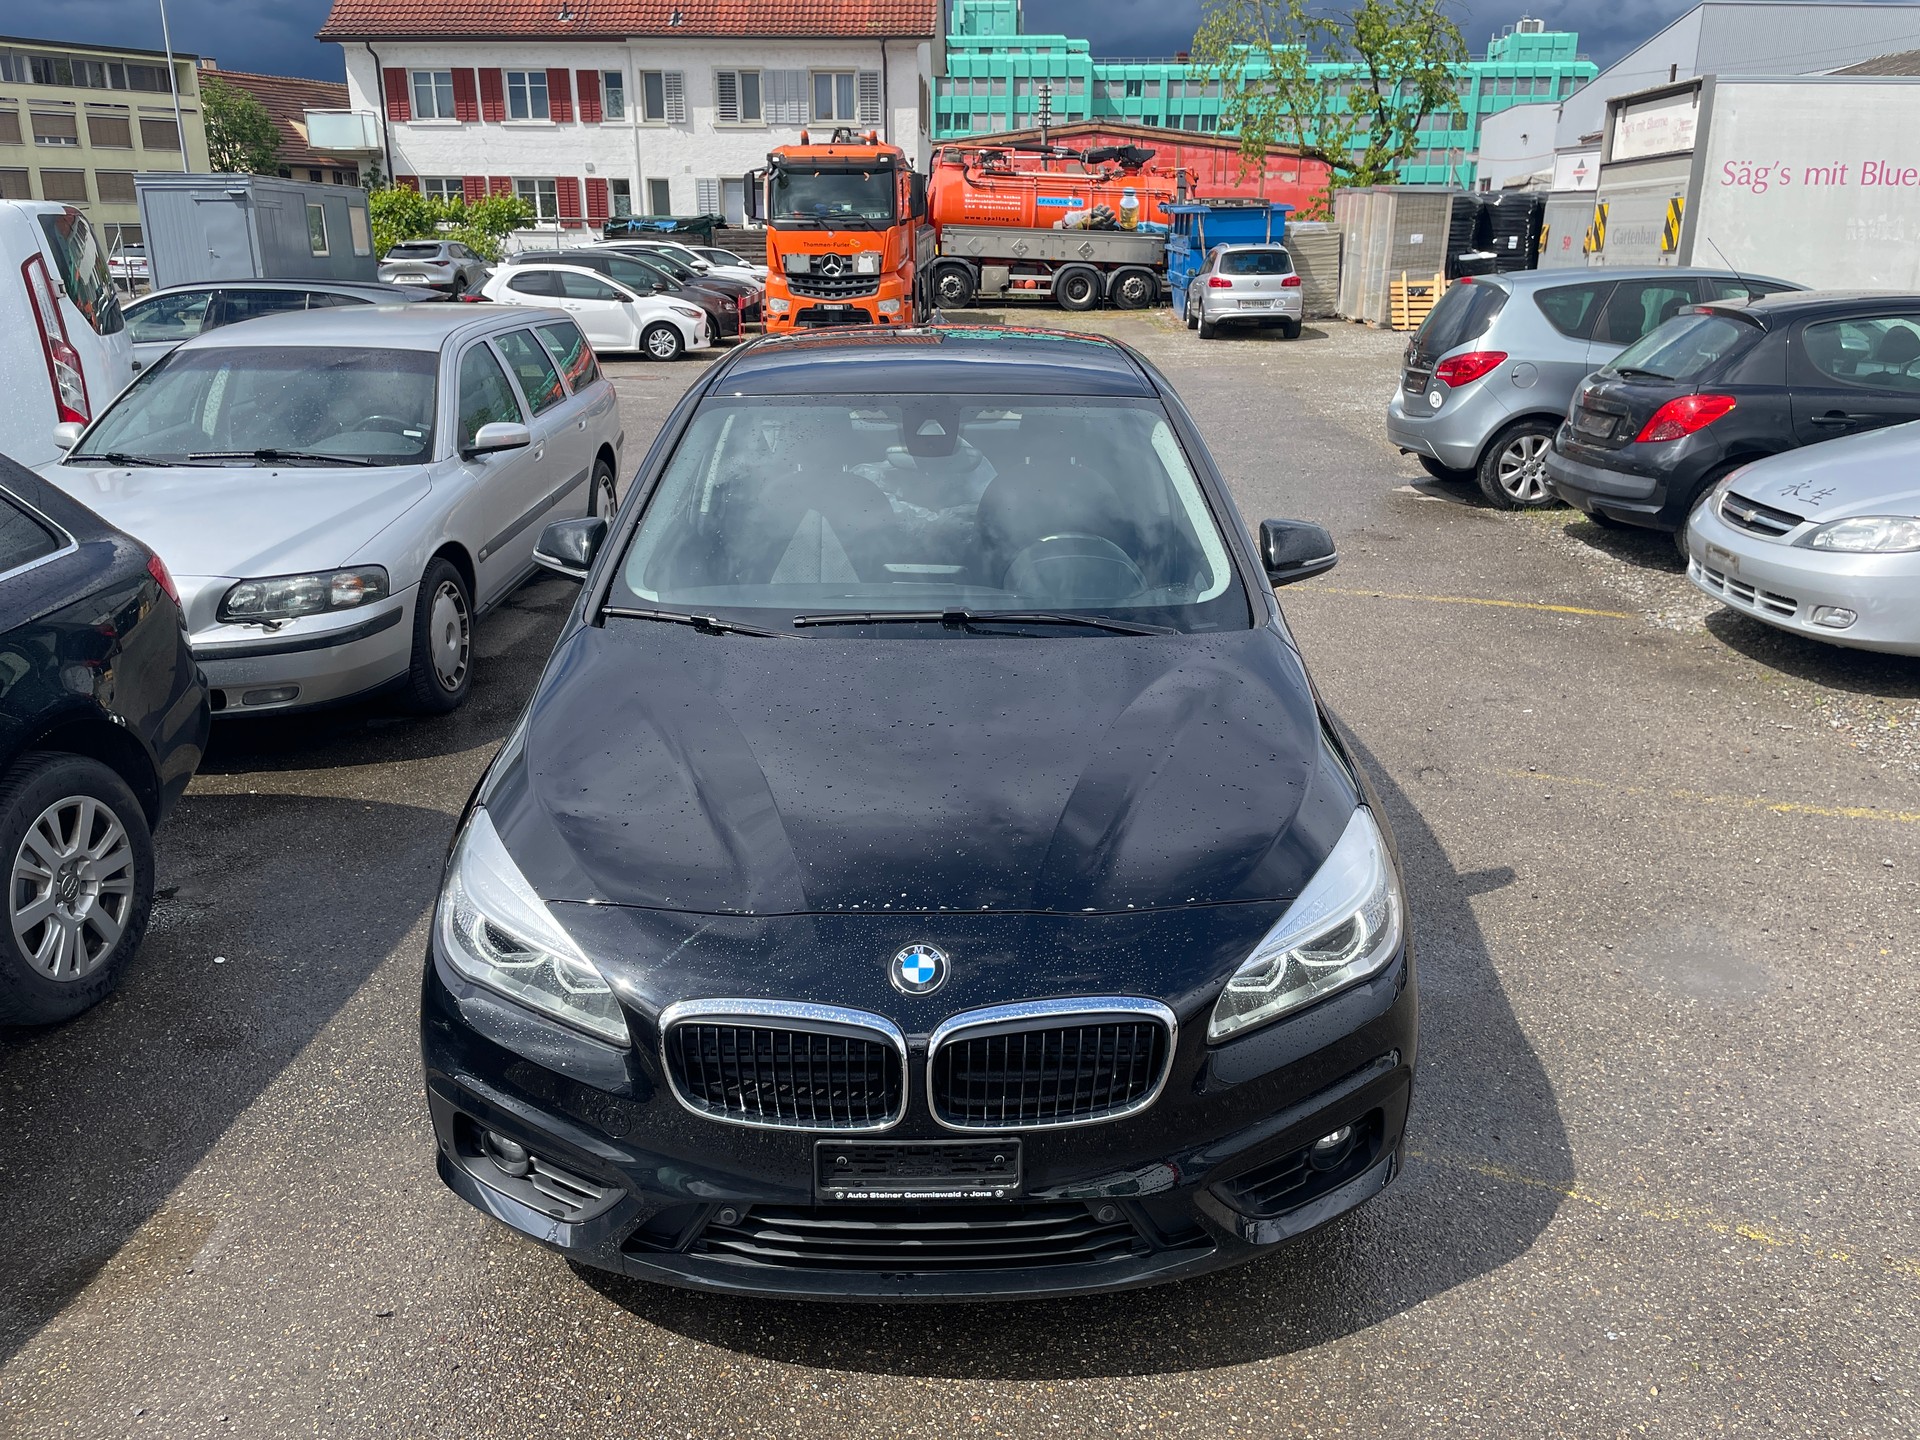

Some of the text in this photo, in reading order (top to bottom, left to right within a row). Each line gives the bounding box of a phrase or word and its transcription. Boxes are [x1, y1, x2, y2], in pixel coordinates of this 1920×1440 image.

[1721, 160, 1920, 194] Säg's mit Blue
[1431, 390, 1440, 405] CH
[897, 945, 941, 962] BMW
[846, 1191, 868, 1199] Auto
[869, 1191, 903, 1199] Steiner
[970, 1190, 992, 1198] Jona
